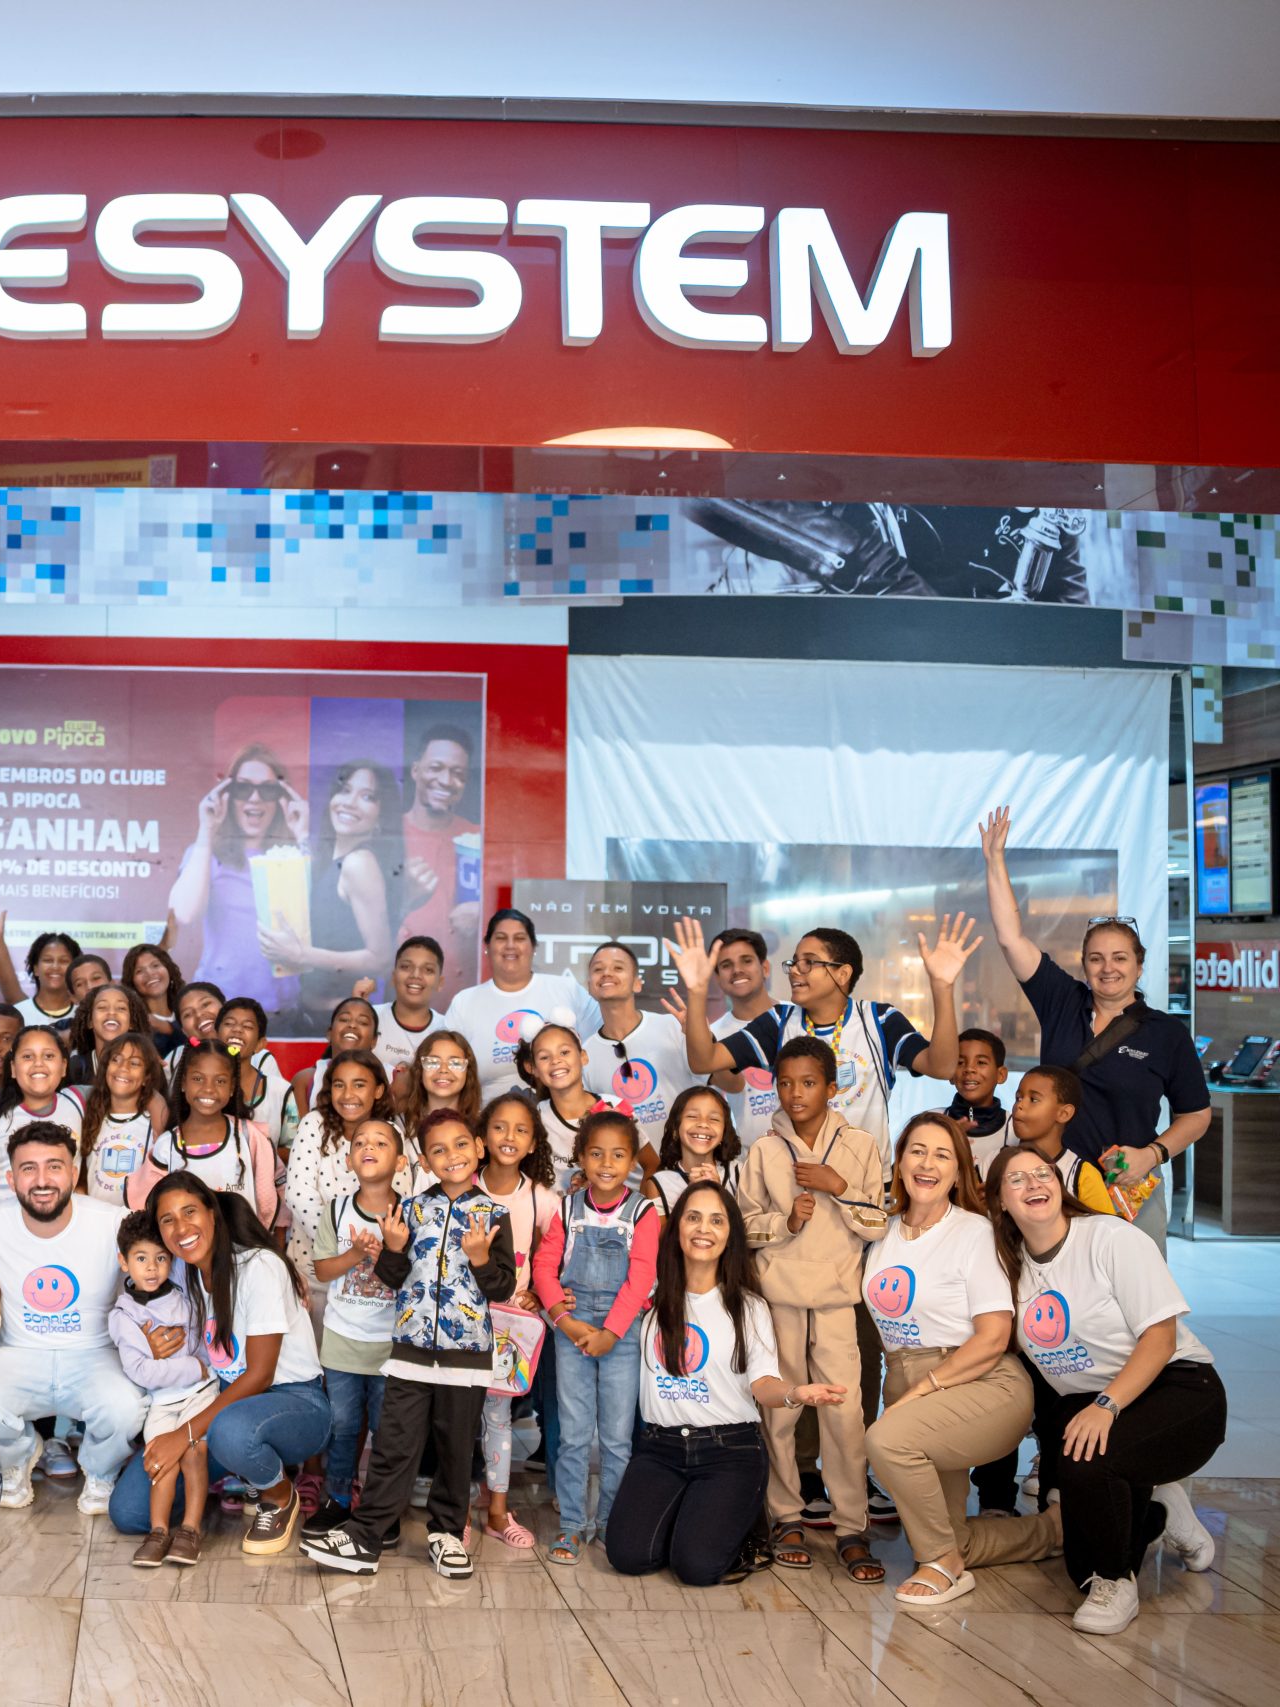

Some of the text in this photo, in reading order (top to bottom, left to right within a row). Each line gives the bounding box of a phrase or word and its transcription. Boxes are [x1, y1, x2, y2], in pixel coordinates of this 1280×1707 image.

[80, 768, 106, 785] DO
[109, 769, 167, 786] CLUBE
[12, 792, 81, 809] PIPOCA
[26, 860, 51, 876] DE
[54, 860, 151, 878] DESCONTO
[32, 882, 120, 899] BENEFÍCIOS!
[530, 900, 712, 915] NÃO TEM VOLTA
[385, 1044, 411, 1056] Projeto
